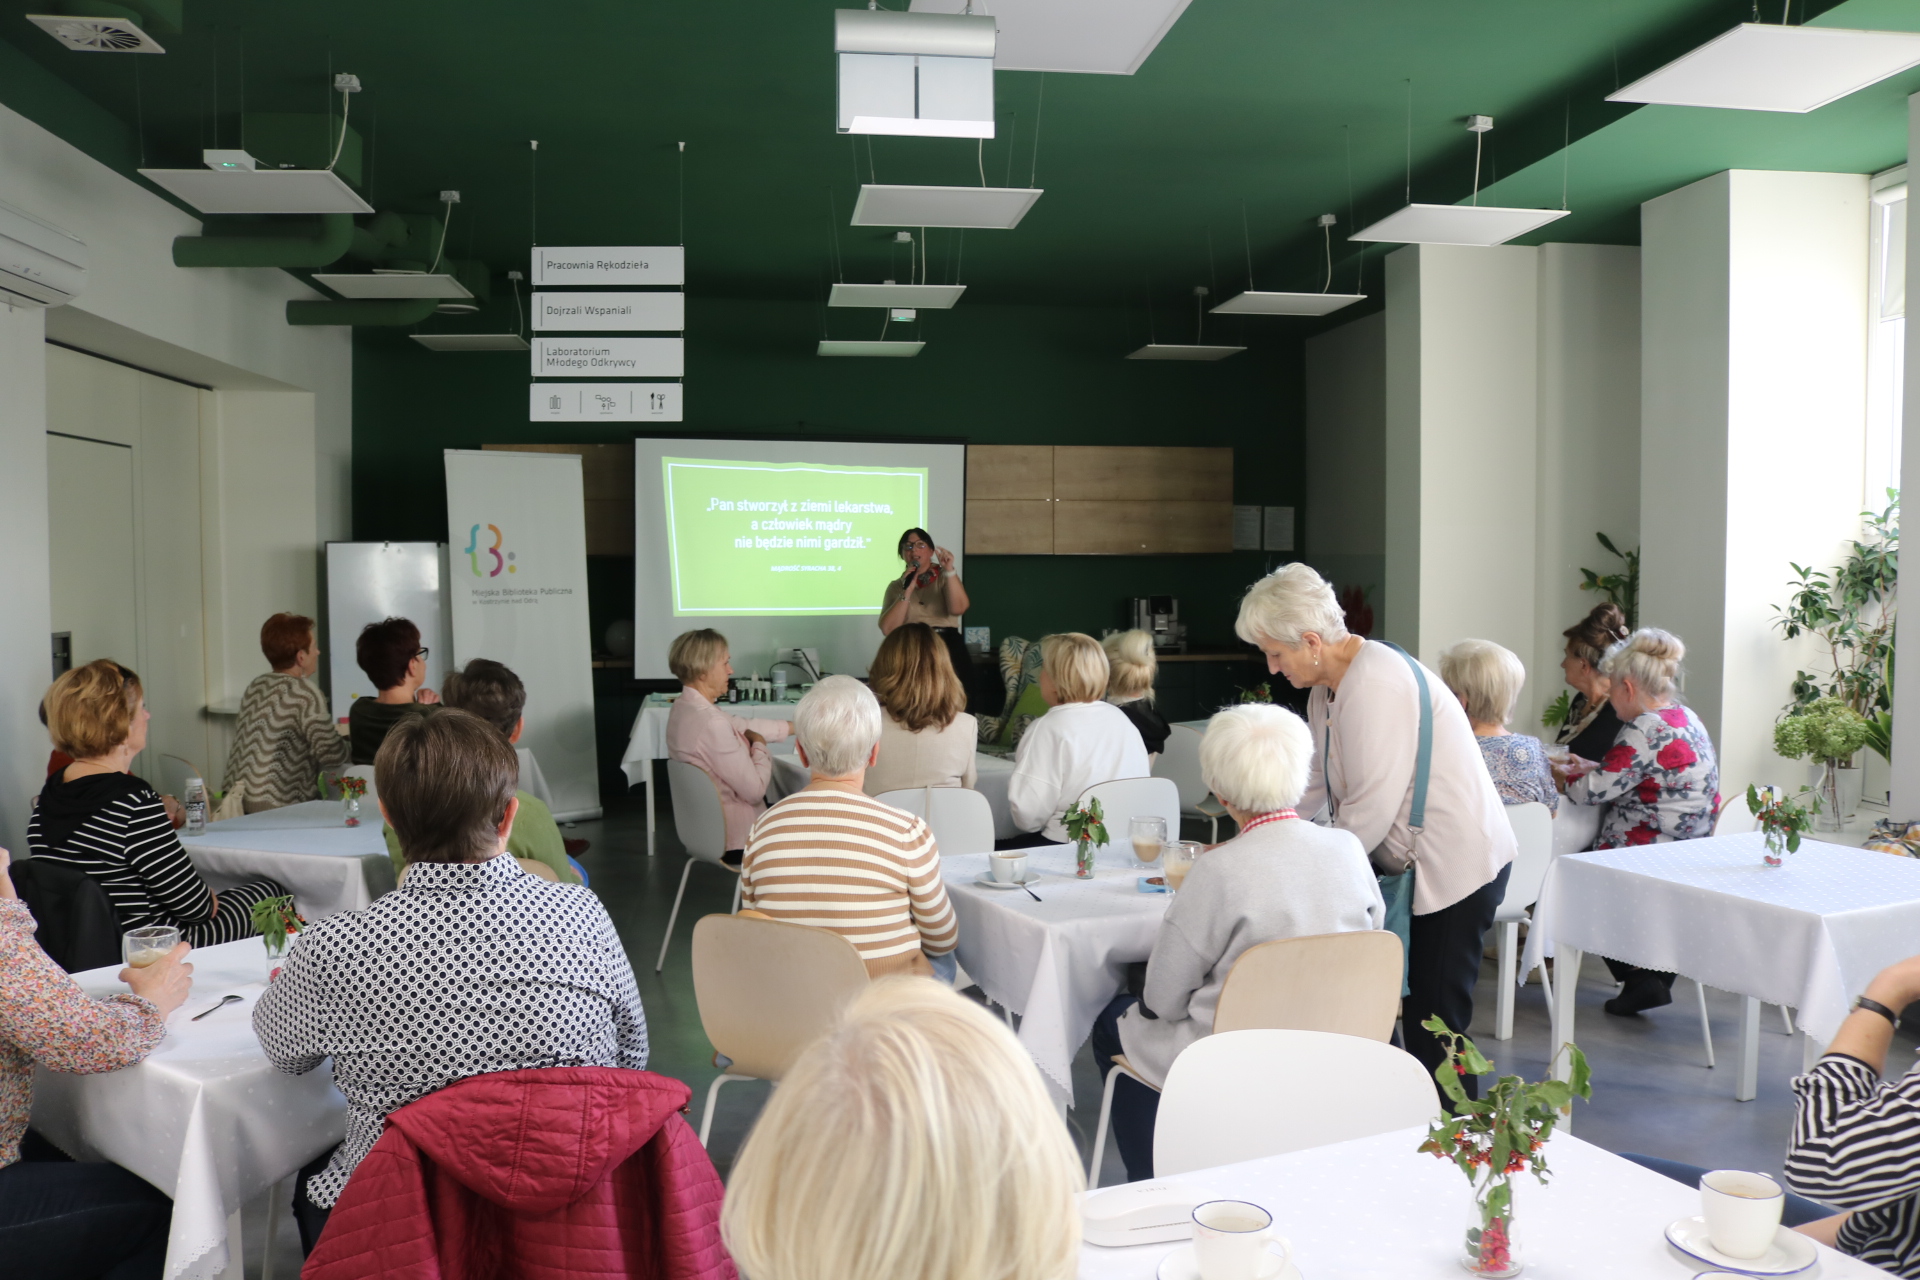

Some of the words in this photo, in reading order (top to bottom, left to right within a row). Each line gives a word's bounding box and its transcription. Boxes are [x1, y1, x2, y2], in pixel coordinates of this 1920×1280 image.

[547, 260, 594, 269] Pracownia
[597, 260, 649, 271] Rękodzieła
[547, 305, 582, 316] Dojrzali
[585, 305, 632, 316] Wspaniali
[547, 347, 610, 356] Laboratorium
[547, 358, 588, 368] Młodego
[591, 358, 636, 368] Odkrywcy
[737, 499, 789, 515] stworzył
[791, 502, 799, 513] z
[801, 498, 833, 513] ziemi
[834, 499, 894, 515] lekarstwa,
[751, 521, 759, 531] a
[762, 517, 814, 531] człowiek
[815, 518, 853, 534] mądry
[735, 536, 754, 549] nie
[755, 535, 794, 551] będzie
[796, 535, 822, 549] nimi
[472, 589, 500, 598] Miejska
[502, 588, 538, 597] Biblioteka
[540, 587, 573, 596] Publiczna
